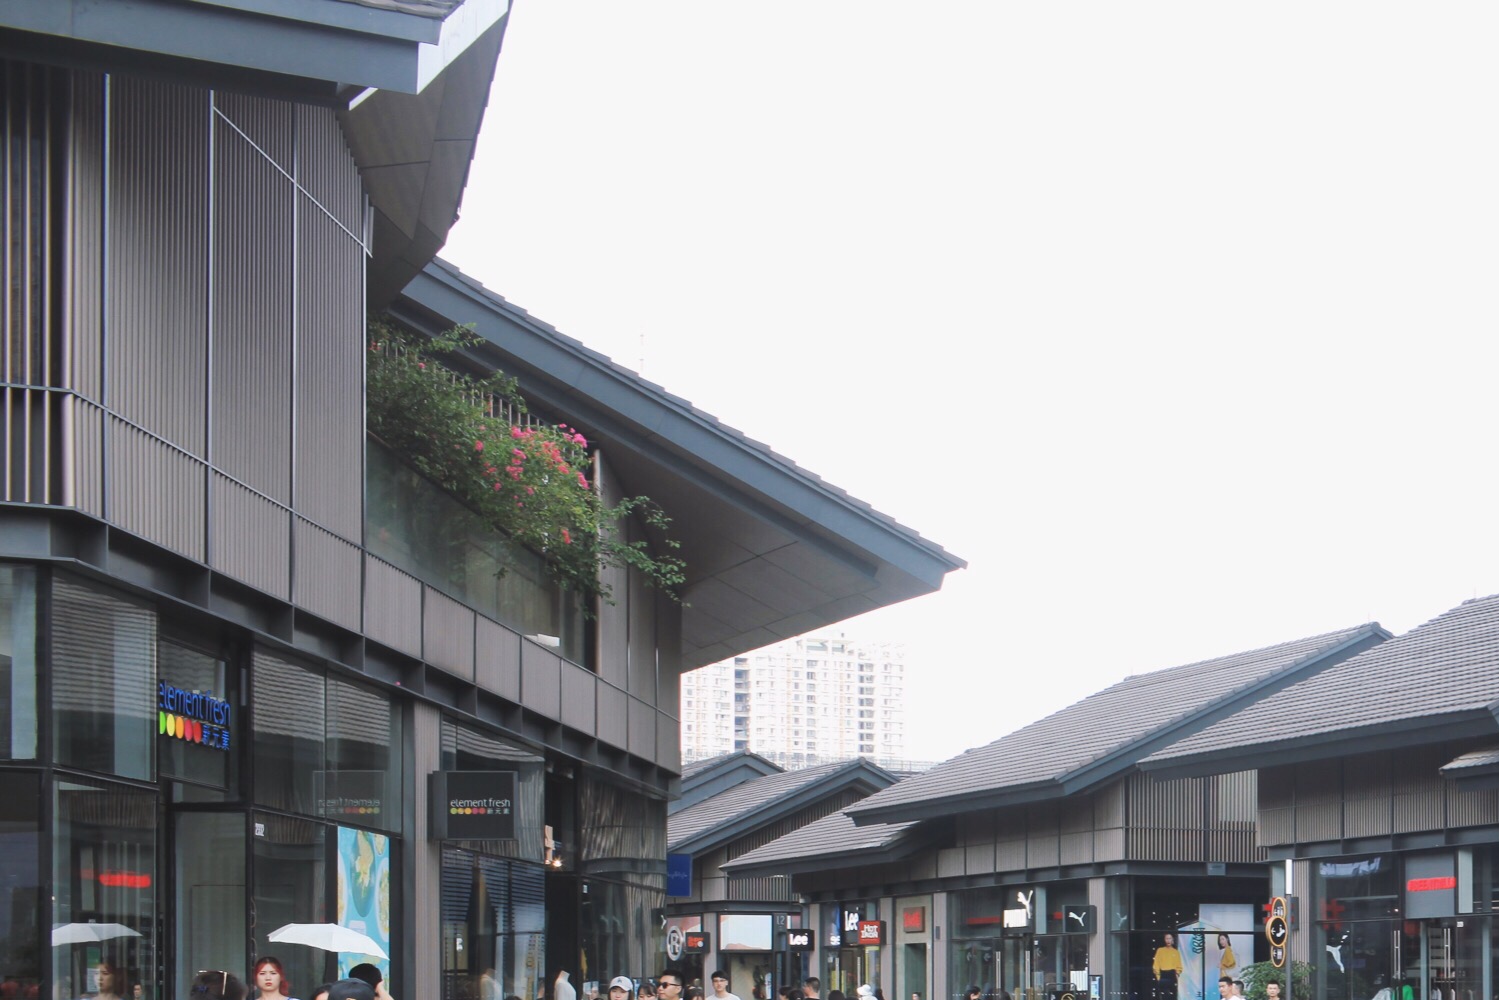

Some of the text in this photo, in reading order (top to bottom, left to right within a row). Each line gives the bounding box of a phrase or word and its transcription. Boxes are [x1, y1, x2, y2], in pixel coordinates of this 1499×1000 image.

[204, 689, 231, 726] fresh
[450, 798, 511, 807] element fresh
[844, 910, 860, 932] Lee
[789, 933, 809, 946] Lee
